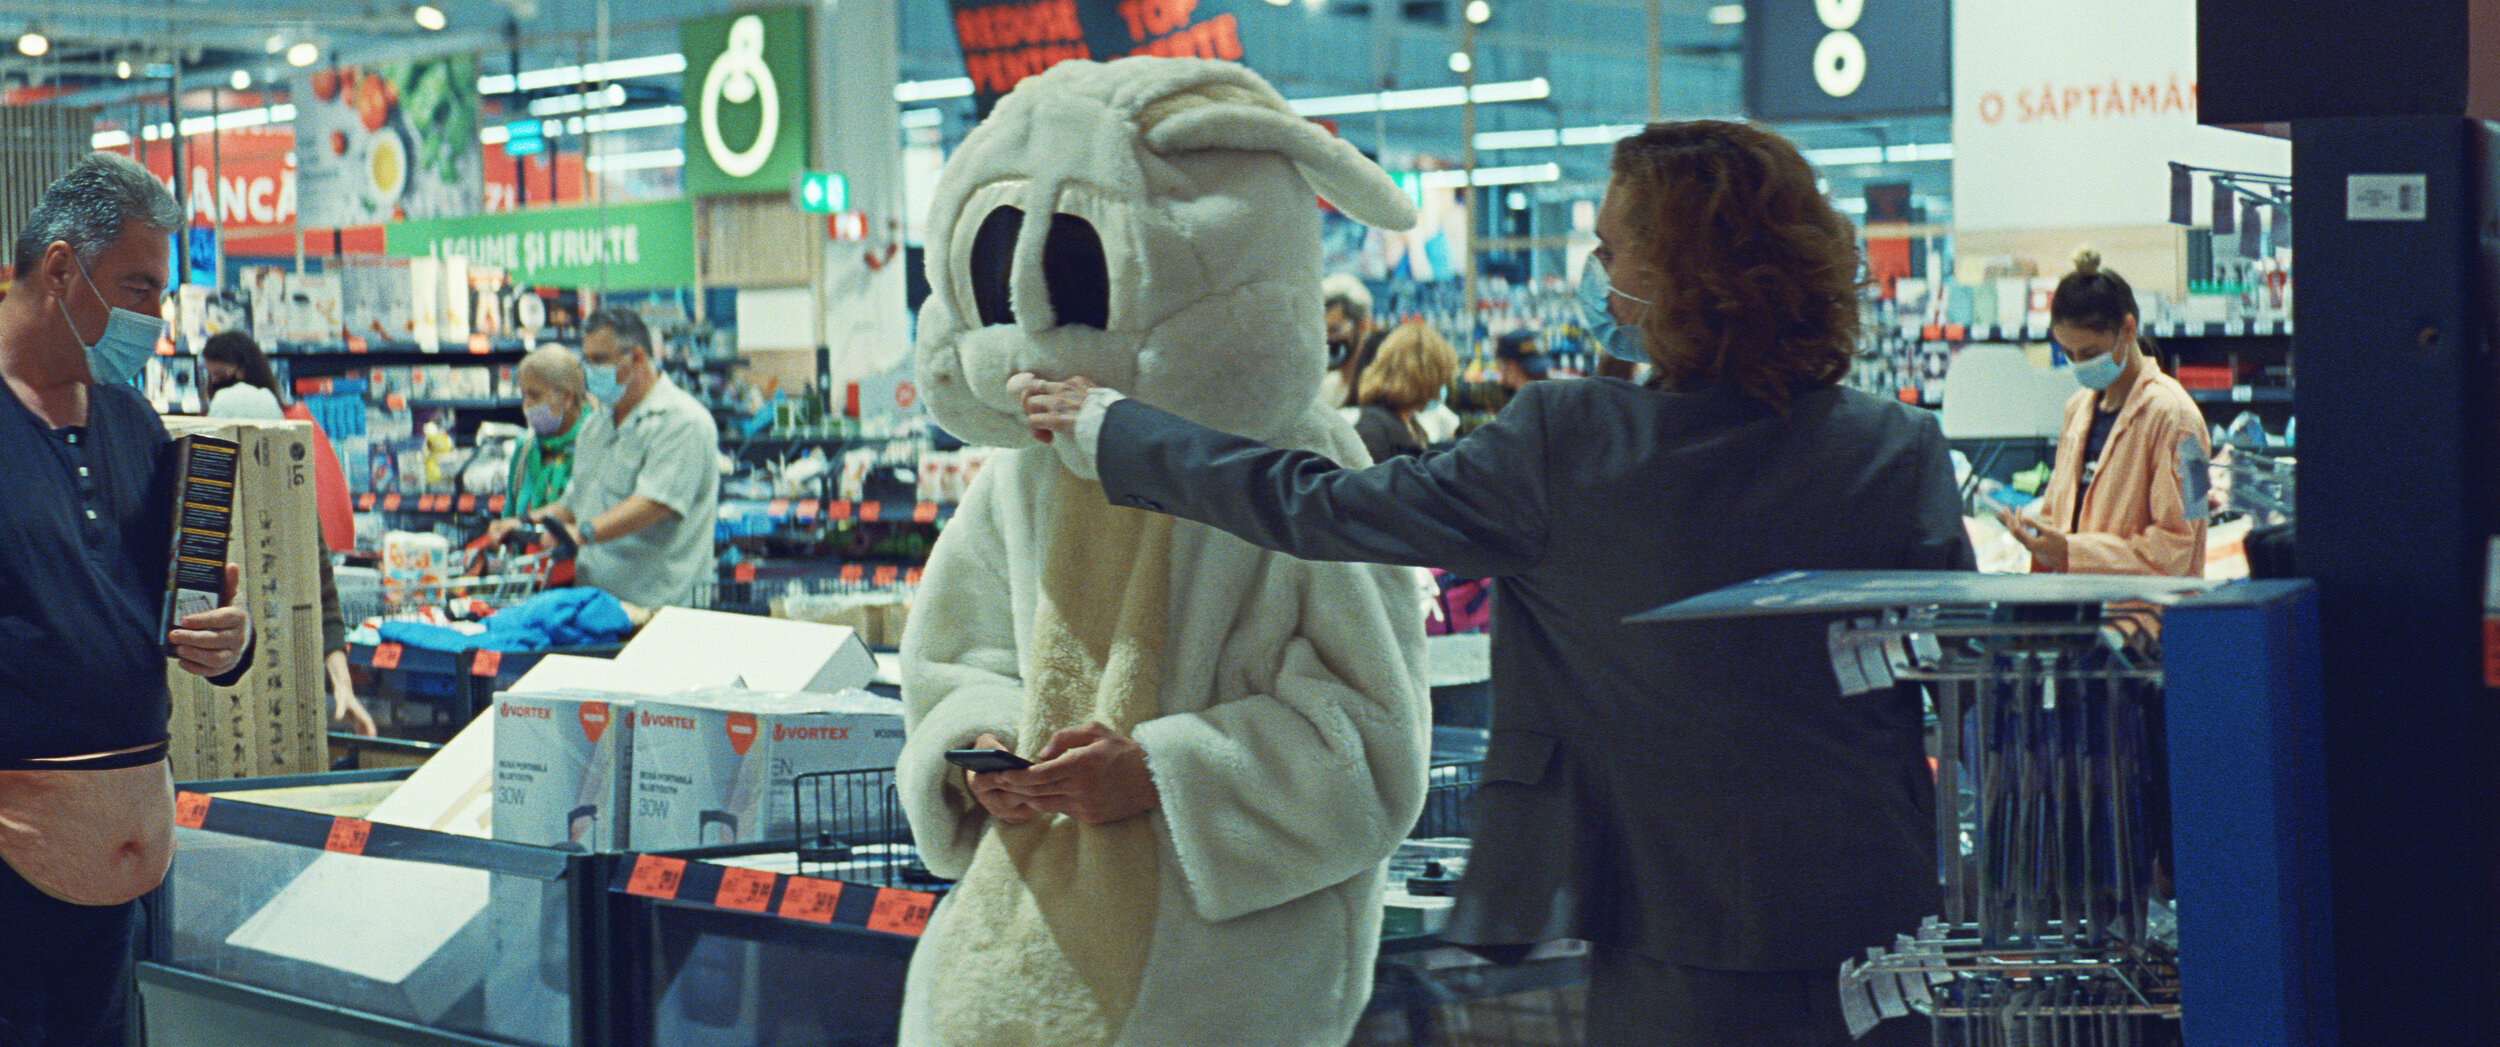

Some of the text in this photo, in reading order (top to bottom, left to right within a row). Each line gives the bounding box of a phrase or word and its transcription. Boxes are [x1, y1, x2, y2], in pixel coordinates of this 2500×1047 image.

[1115, 0, 1198, 43] TOP
[1979, 90, 2004, 126] O
[154, 163, 297, 224] ÂNCĂ
[550, 223, 639, 268] FRUCTE
[292, 464, 305, 486] LG
[510, 705, 552, 720] VORTEX
[651, 713, 697, 730] VORTEX
[785, 726, 850, 740] VORTEX
[498, 785, 525, 805] 30W
[639, 798, 669, 818] 30W
